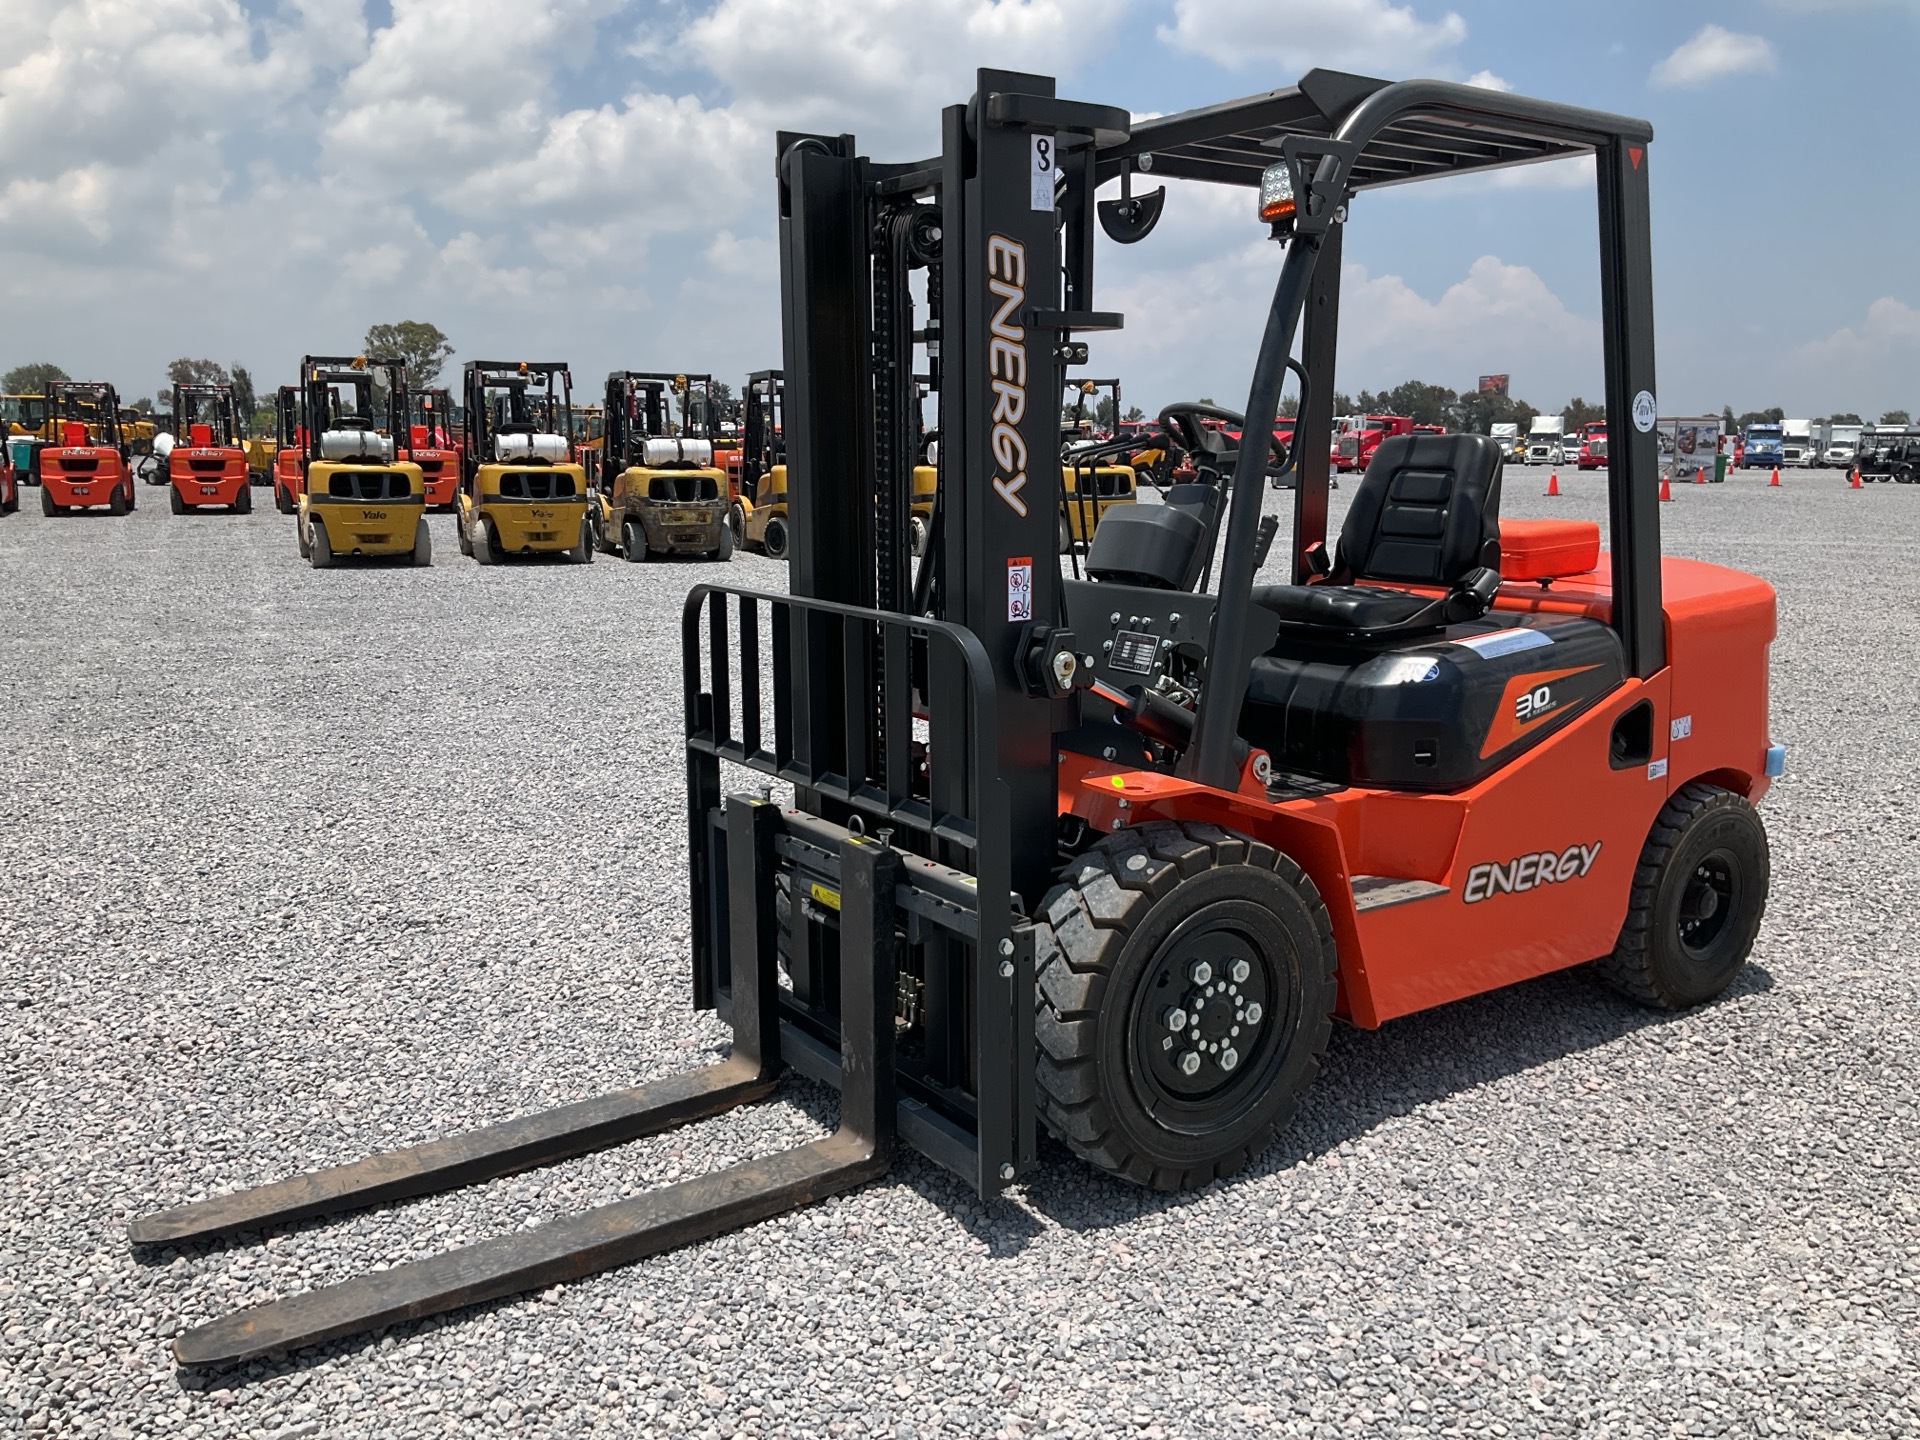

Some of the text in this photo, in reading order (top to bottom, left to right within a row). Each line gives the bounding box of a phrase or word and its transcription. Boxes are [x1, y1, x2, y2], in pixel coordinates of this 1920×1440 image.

[987, 233, 1028, 518] ENERGY
[362, 510, 387, 520] Yale
[1515, 686, 1550, 718] 30
[1463, 840, 1603, 904] ENERGY
